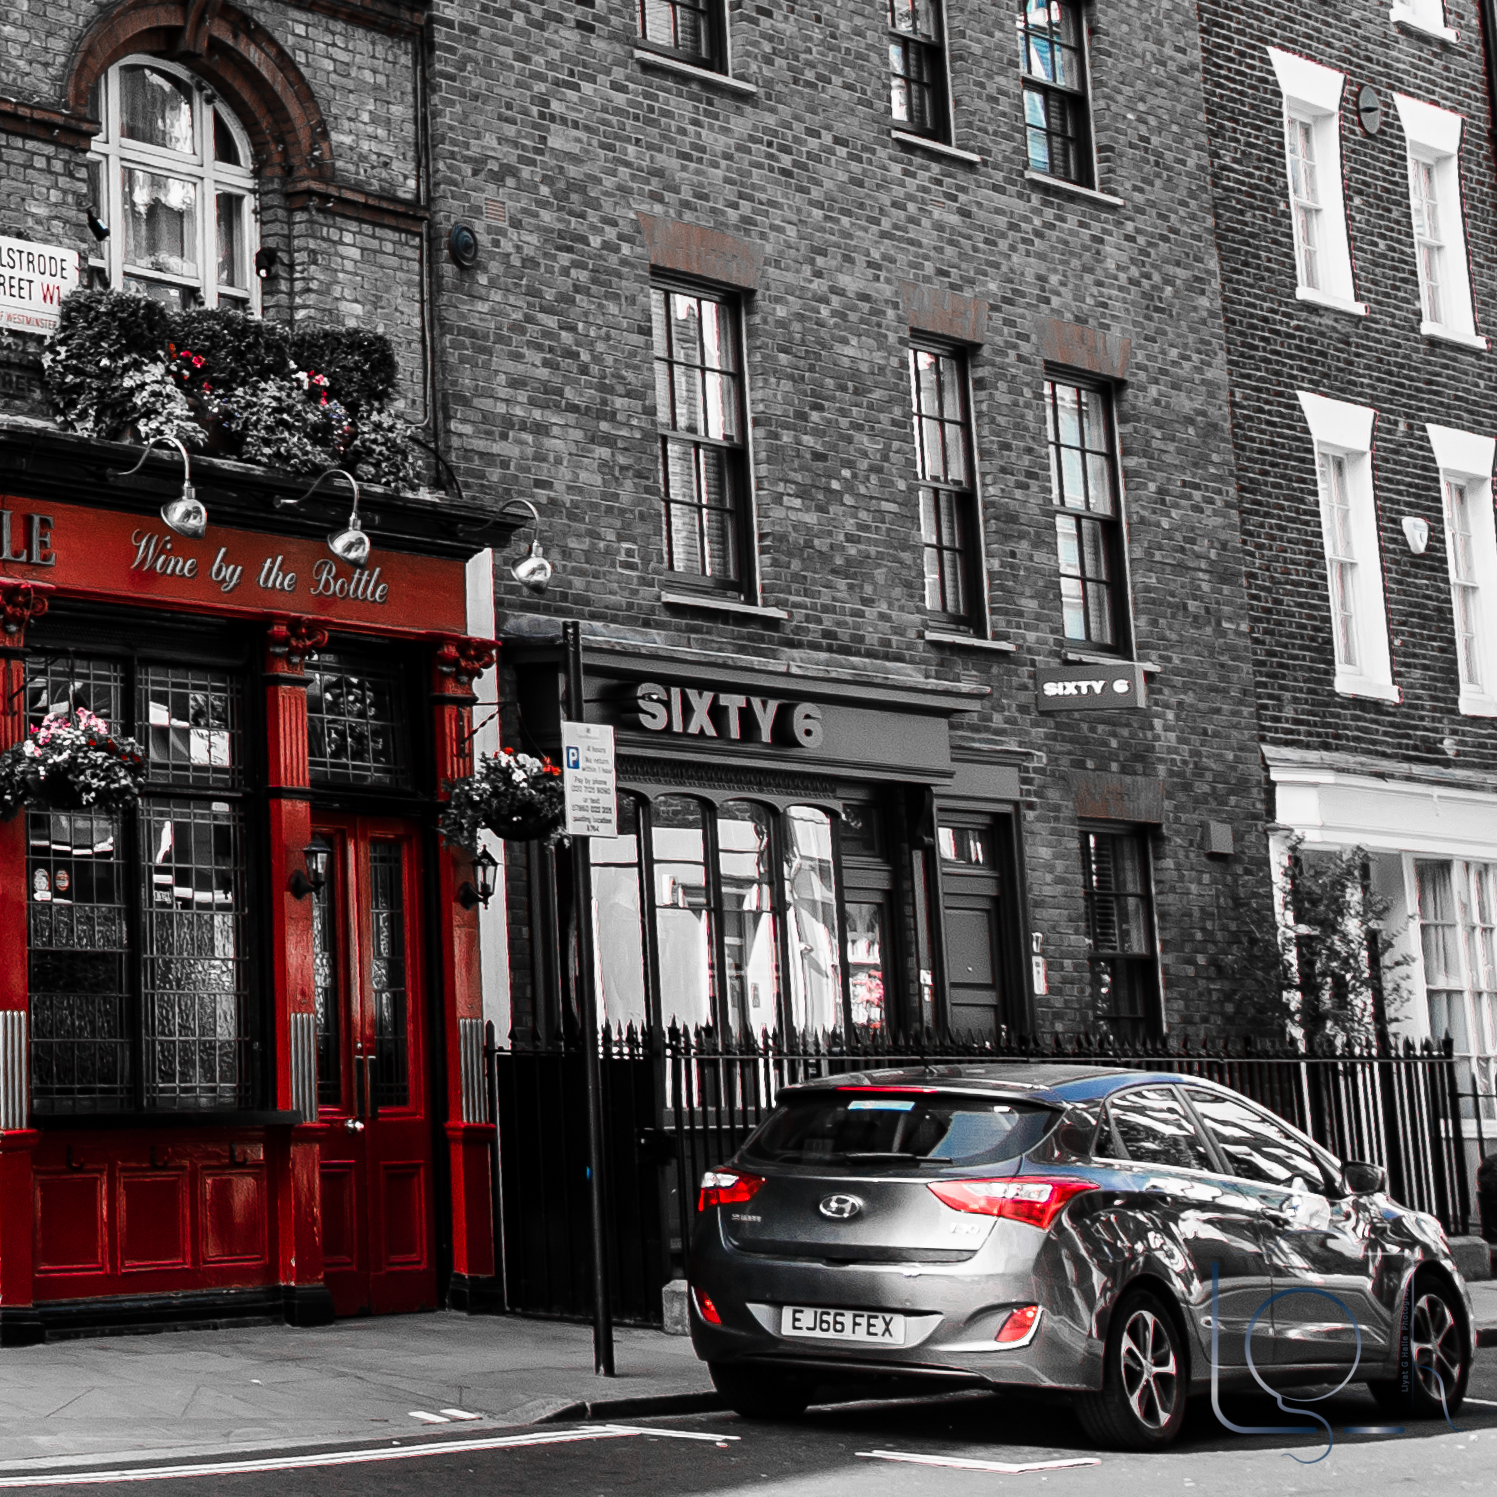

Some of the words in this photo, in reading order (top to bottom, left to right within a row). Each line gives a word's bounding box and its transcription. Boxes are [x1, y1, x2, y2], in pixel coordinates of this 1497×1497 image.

[41, 282, 61, 306] W1
[6, 312, 57, 329] WESTMINSTER
[130, 528, 199, 578] Wine
[209, 547, 243, 594] by
[257, 556, 297, 592] the
[309, 558, 390, 604] Bottle
[1043, 680, 1107, 697] SIXTY
[1113, 679, 1133, 696] 6
[636, 682, 782, 744] SIXTY
[793, 702, 824, 749] 6
[569, 748, 578, 768] P
[791, 1308, 846, 1334] EJ66
[852, 1313, 895, 1338] FEX
